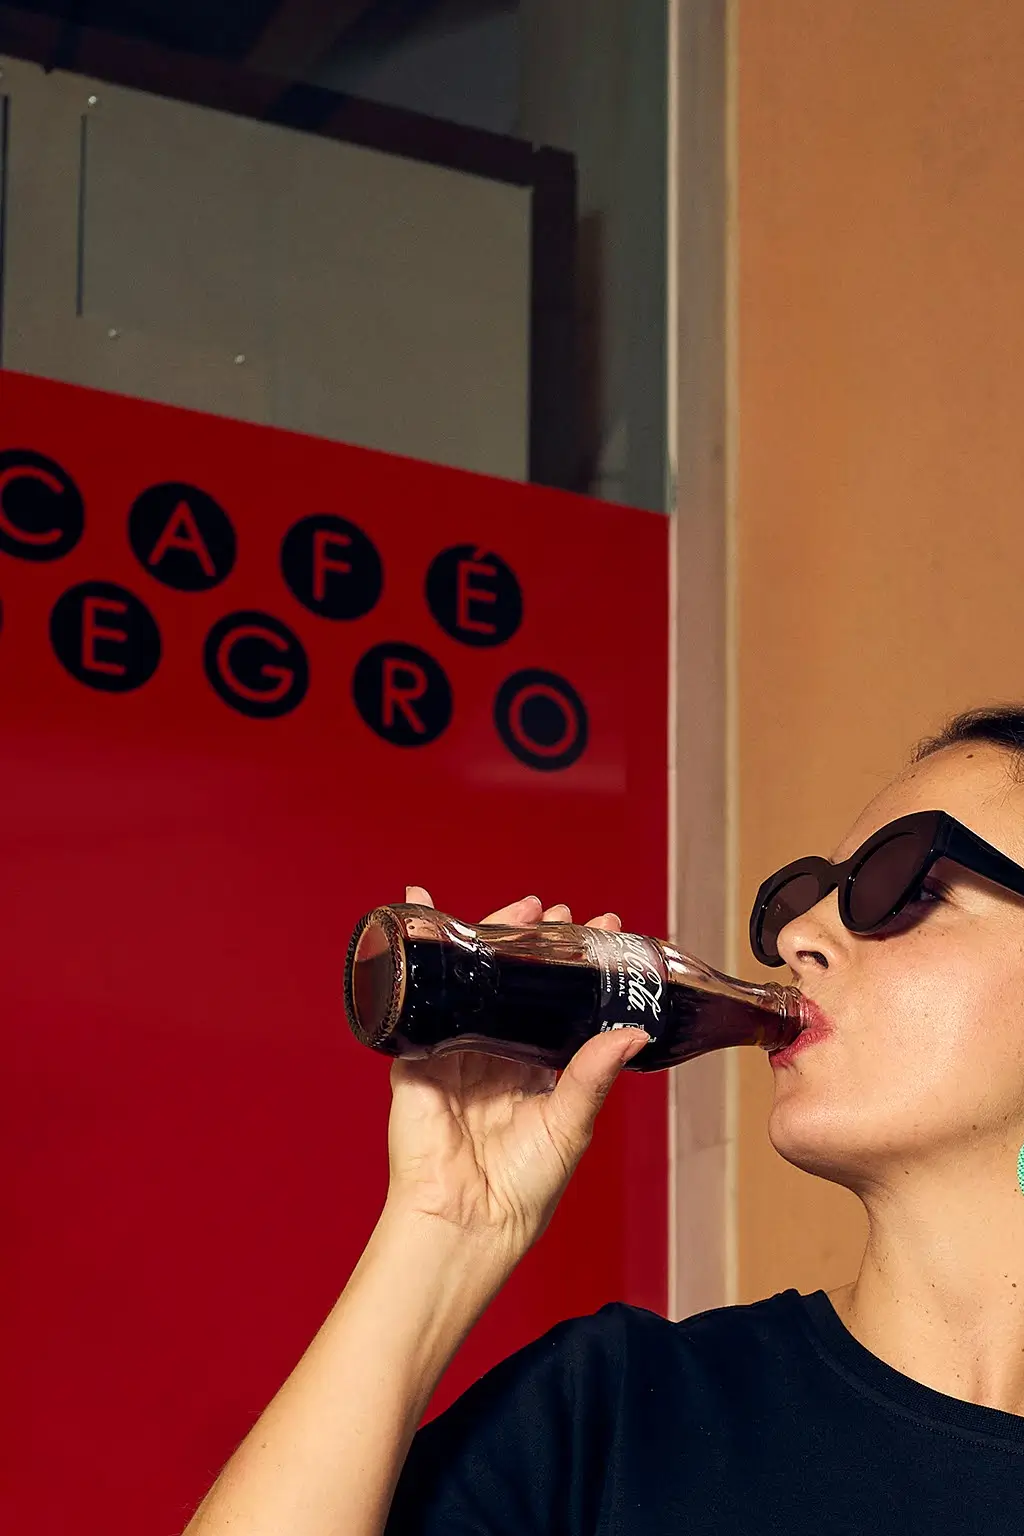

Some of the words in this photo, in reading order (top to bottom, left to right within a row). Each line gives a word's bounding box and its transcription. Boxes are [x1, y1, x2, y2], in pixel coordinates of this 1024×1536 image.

[0, 465, 498, 634] CAFÉ
[82, 596, 578, 757] EGRO
[613, 950, 626, 997] ORIGINAL
